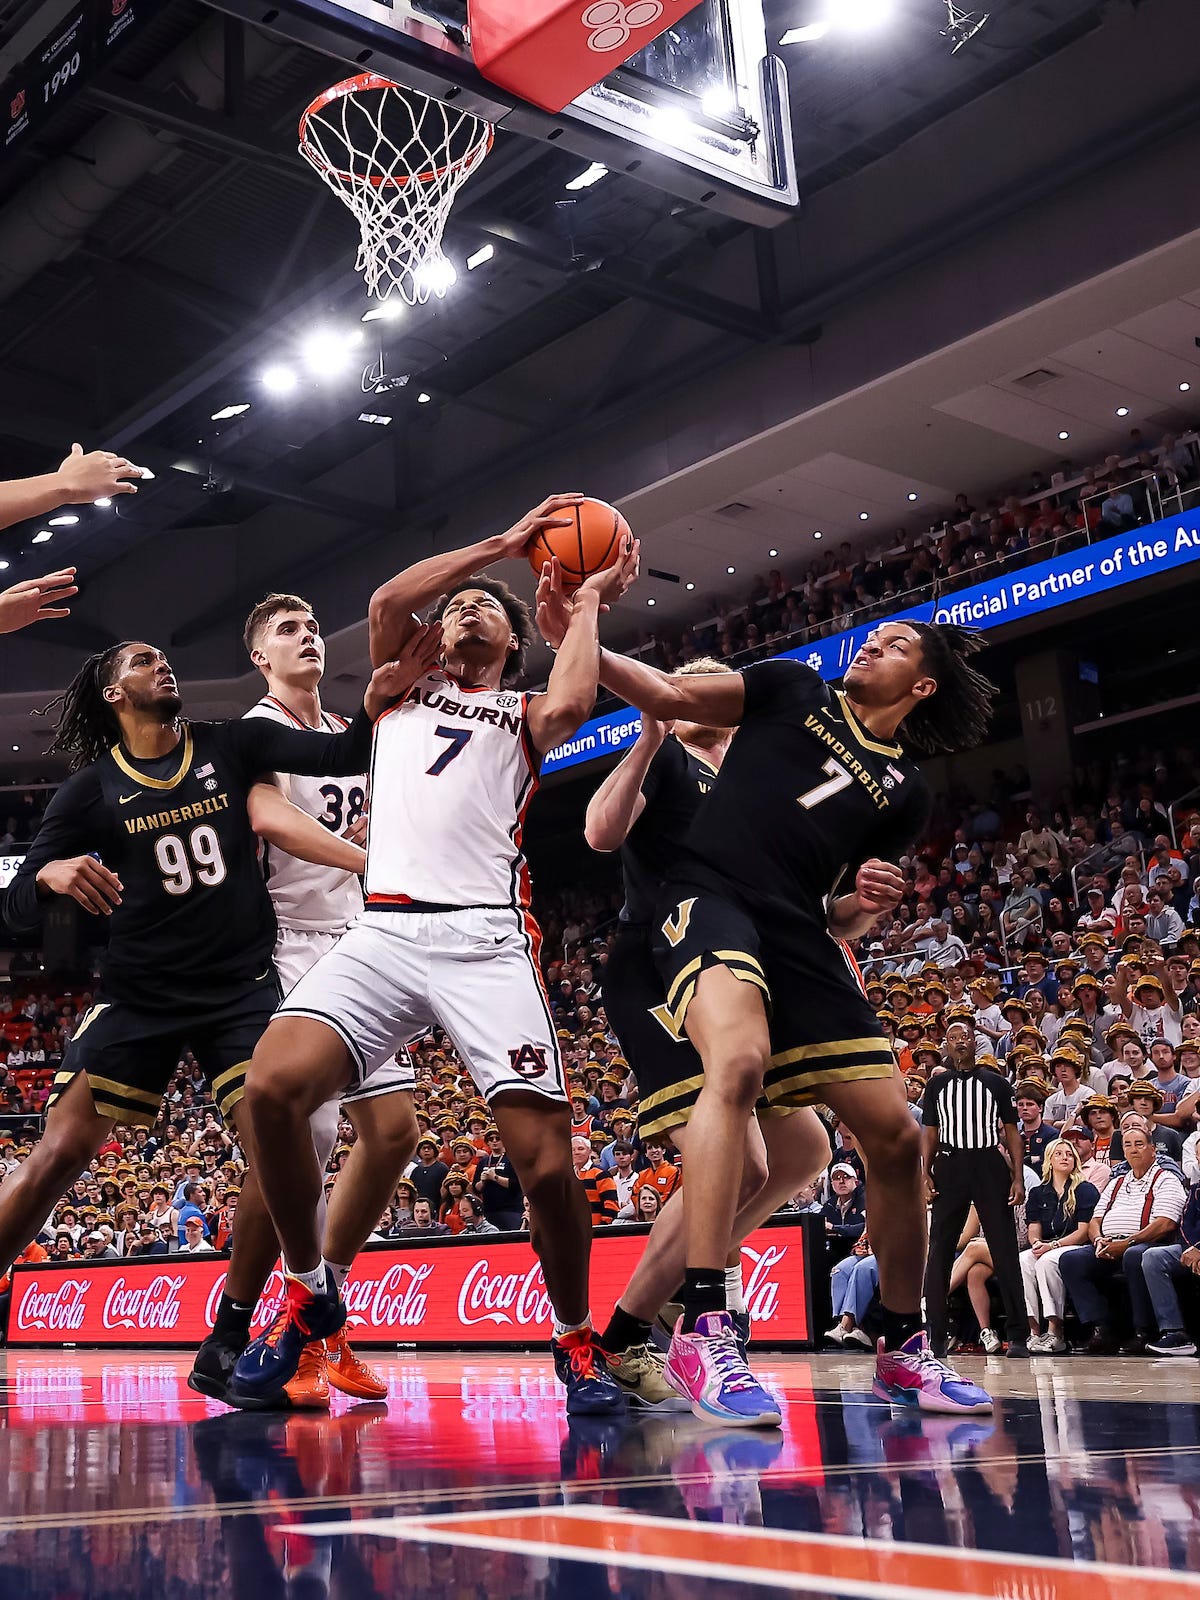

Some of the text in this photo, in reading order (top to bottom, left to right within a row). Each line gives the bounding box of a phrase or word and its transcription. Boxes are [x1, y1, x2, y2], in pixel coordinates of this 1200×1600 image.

[43, 51, 80, 103] 1990
[935, 589, 1008, 626] Official
[1012, 563, 1095, 606] Partner
[1100, 548, 1124, 577] of
[1127, 540, 1168, 567] the
[404, 687, 523, 737] AUBURN
[1025, 698, 1057, 721] 112
[425, 724, 474, 777] 7
[544, 719, 643, 764] Auburn Tigers
[803, 714, 891, 810] VANDERBILT
[318, 784, 365, 833] 38
[796, 755, 855, 810] 7
[124, 793, 230, 834] VANDERBILT
[154, 824, 228, 896] 99
[17, 1279, 92, 1330] Coca-Cola
[102, 1274, 188, 1330] Coca-Cola
[340, 1263, 435, 1327] oca-Cola
[457, 1259, 555, 1325] Coca-Co
